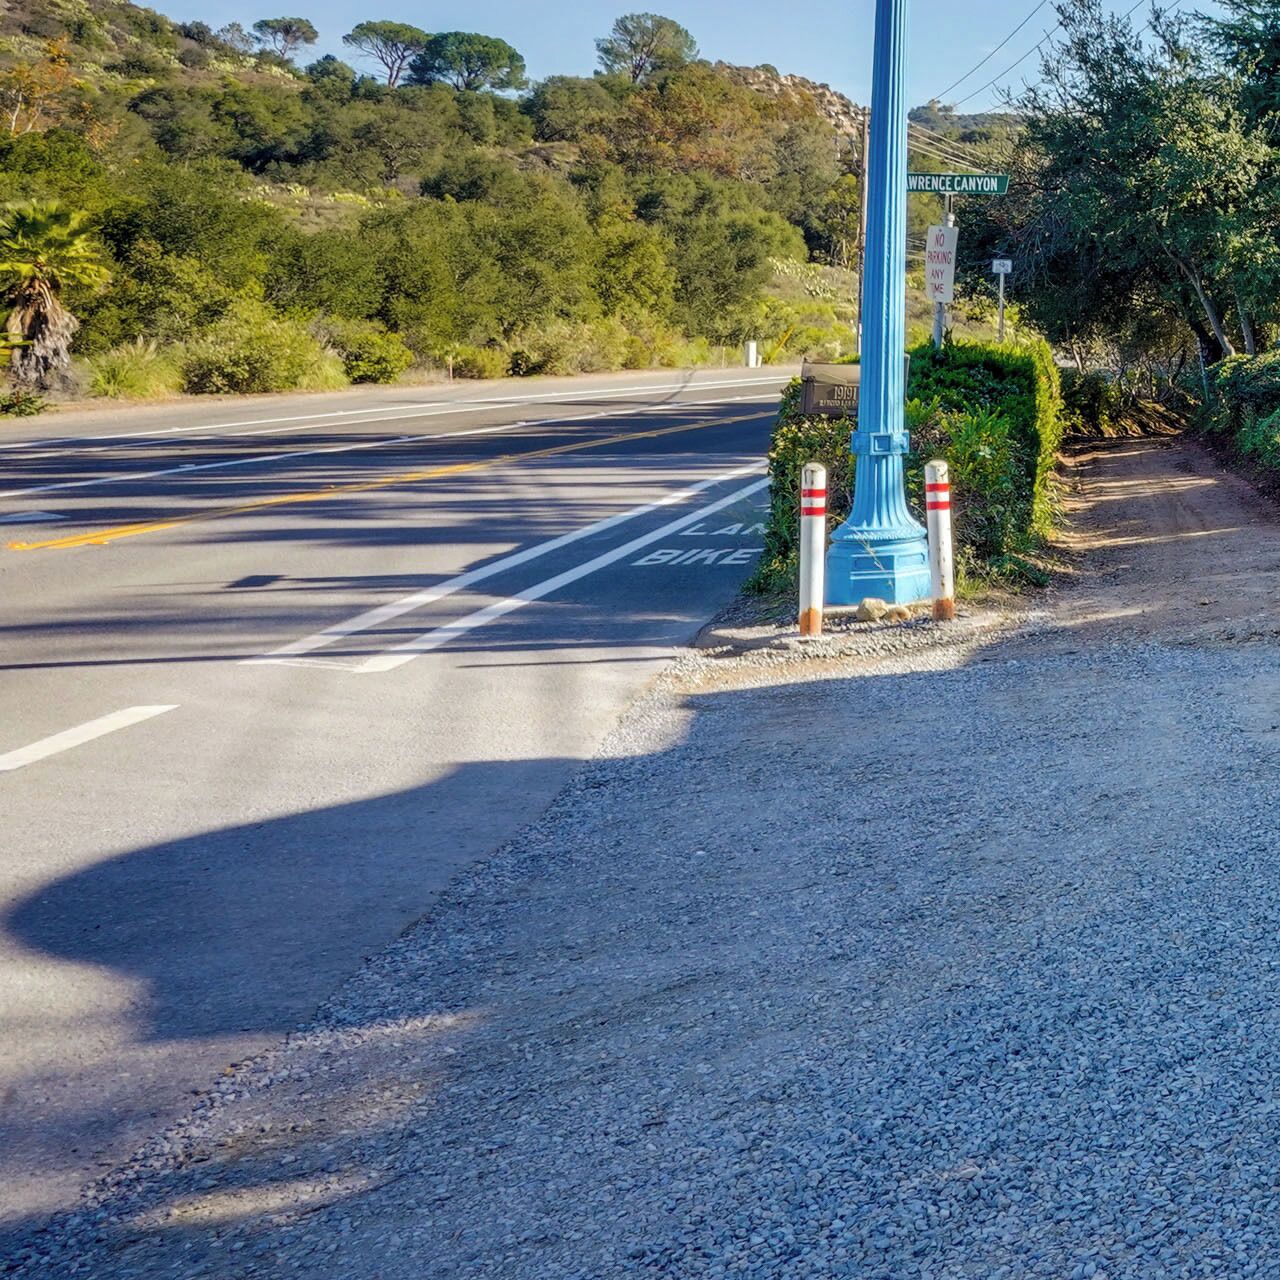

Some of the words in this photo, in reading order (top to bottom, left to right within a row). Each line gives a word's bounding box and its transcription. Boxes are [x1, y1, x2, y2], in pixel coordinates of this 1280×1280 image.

[907, 175, 952, 191] WRENCE
[954, 176, 998, 192] CANYON
[935, 233, 945, 247] NO
[928, 250, 952, 265] PARKING
[931, 269, 945, 280] ANY
[834, 386, 857, 401] 19191
[631, 548, 766, 566] BIKE
